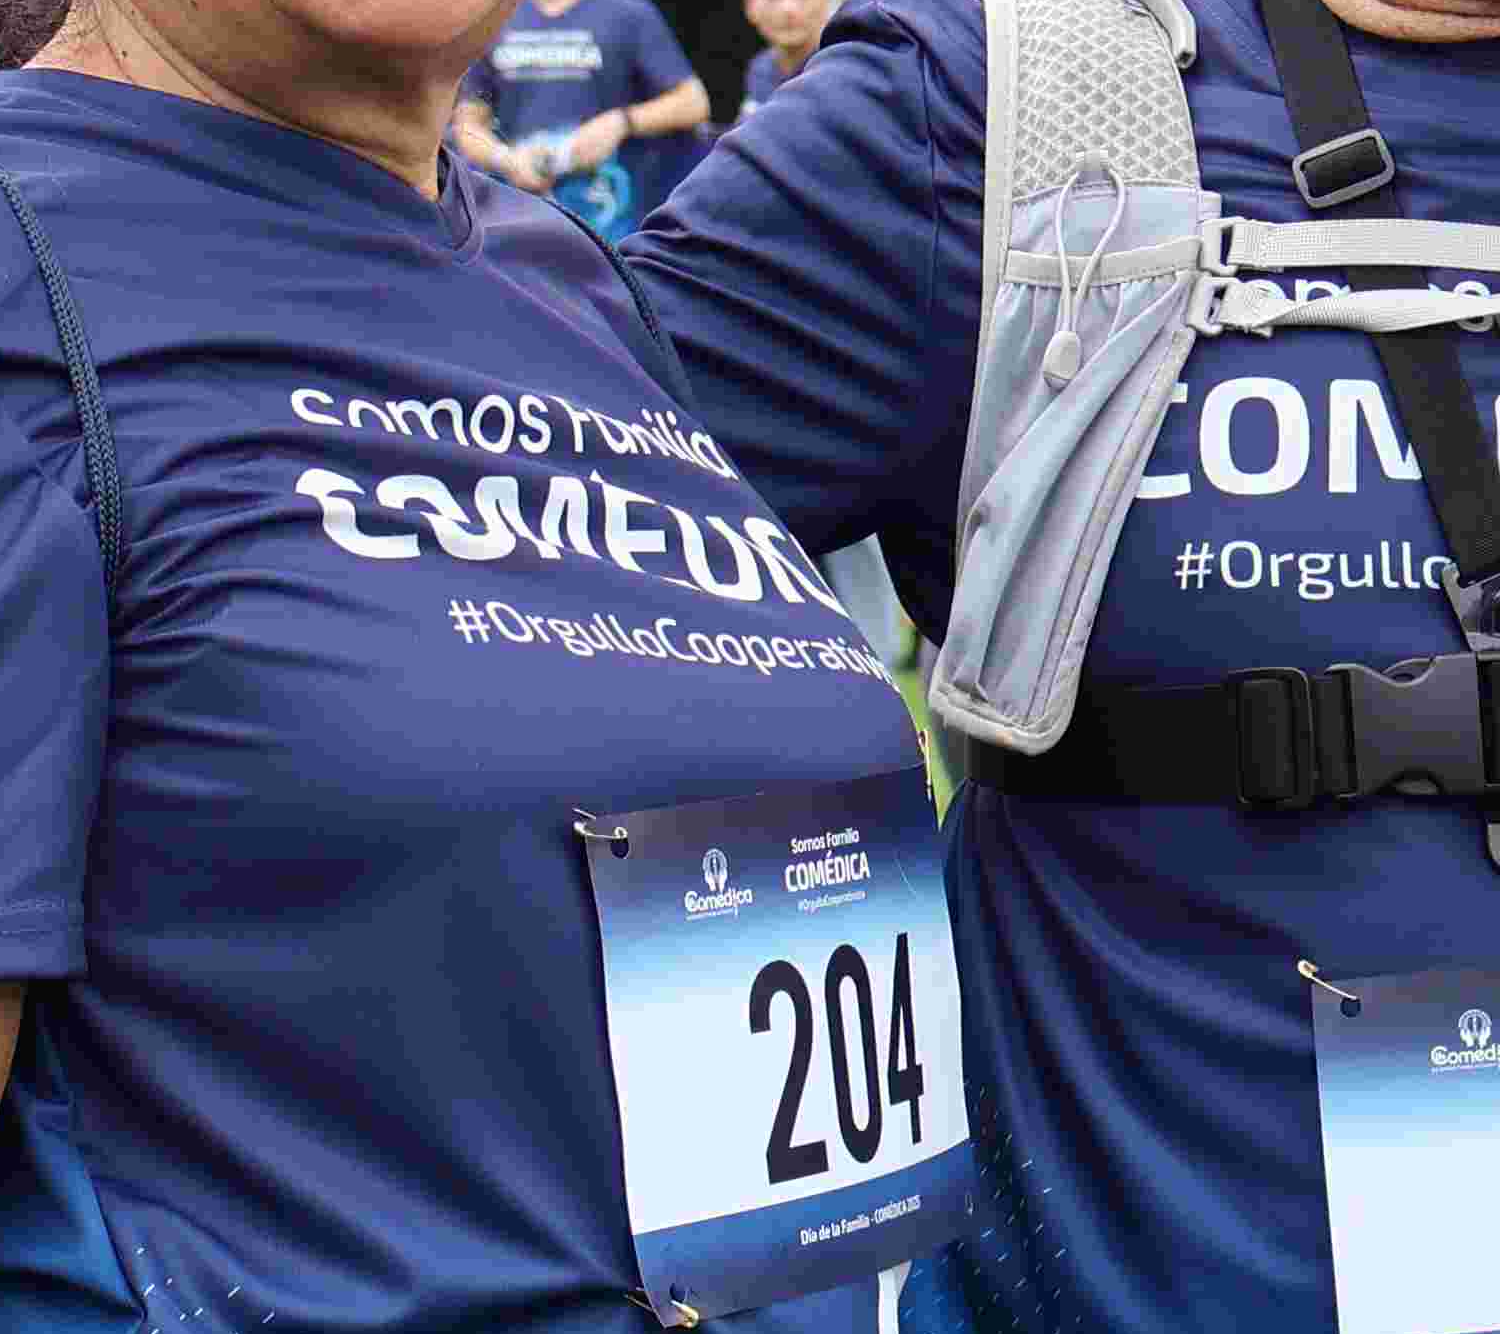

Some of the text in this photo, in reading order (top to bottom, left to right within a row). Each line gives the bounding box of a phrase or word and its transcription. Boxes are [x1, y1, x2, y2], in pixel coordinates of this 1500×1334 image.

[790, 835, 826, 854] Somos
[784, 850, 871, 893] COMÉDICA
[748, 932, 926, 1186] 204
